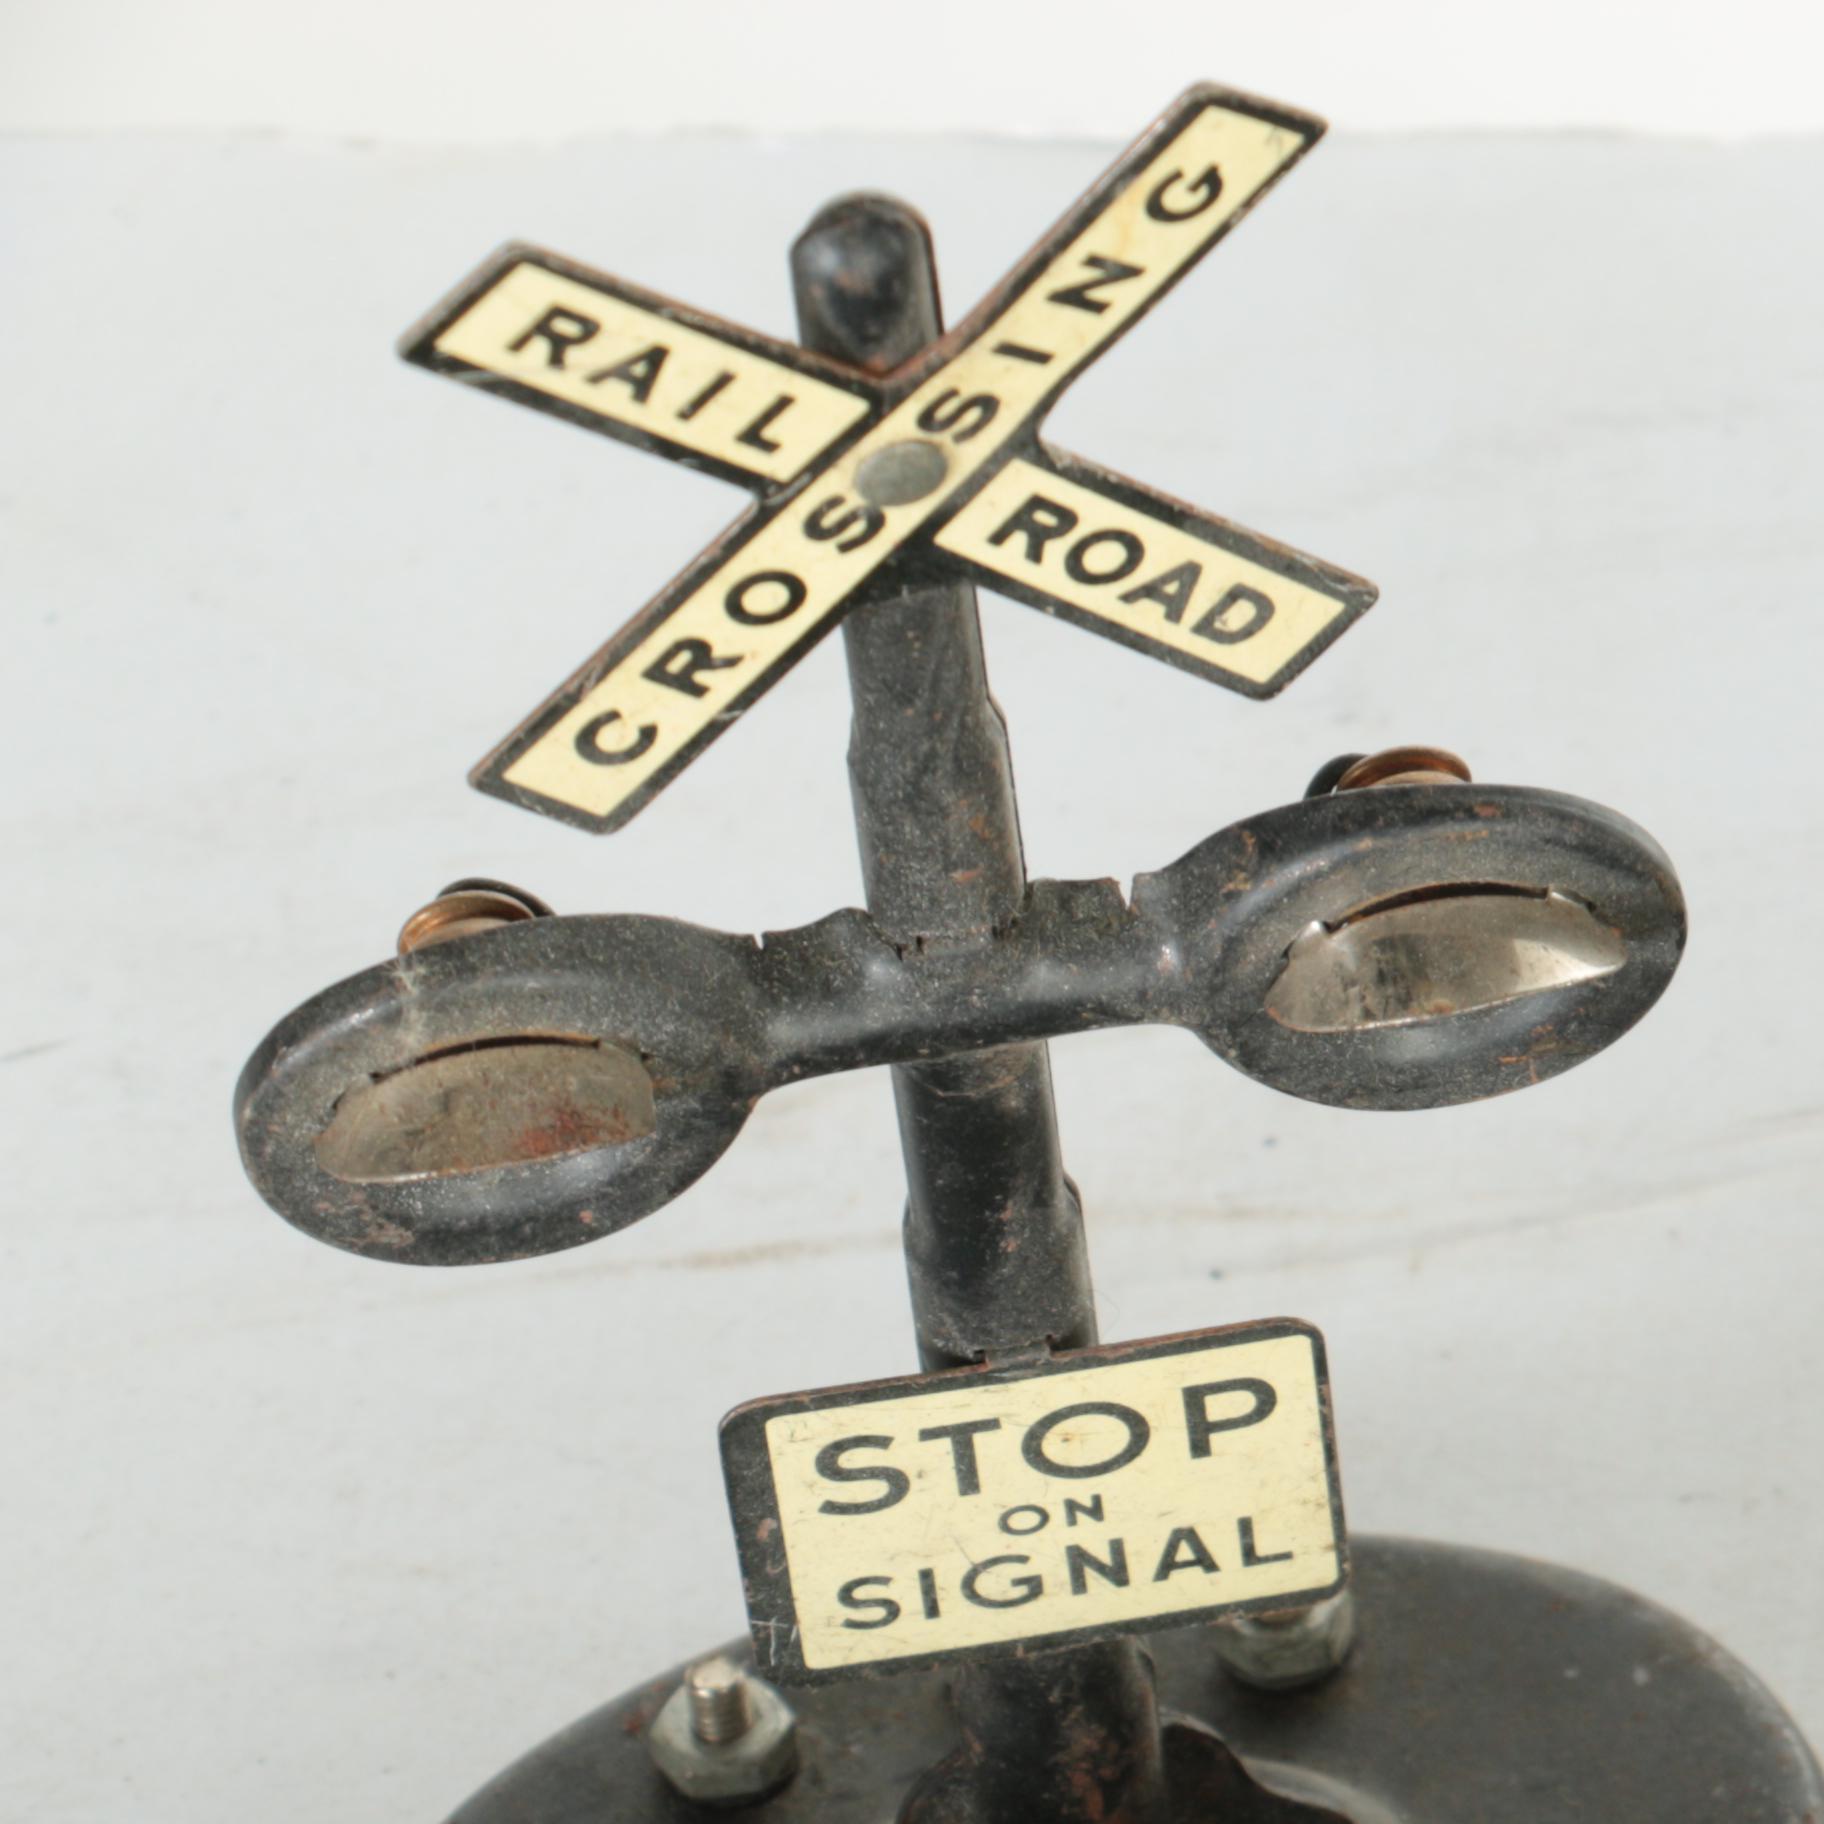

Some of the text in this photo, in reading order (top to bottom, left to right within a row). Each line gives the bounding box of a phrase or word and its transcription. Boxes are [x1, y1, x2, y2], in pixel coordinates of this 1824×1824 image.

[506, 304, 1277, 647] RAIL ROAD
[571, 161, 1227, 768] CROSSING
[813, 1376, 1278, 1516] STOP
[998, 1494, 1105, 1536] ON
[836, 1516, 1293, 1631] SIGNAL
